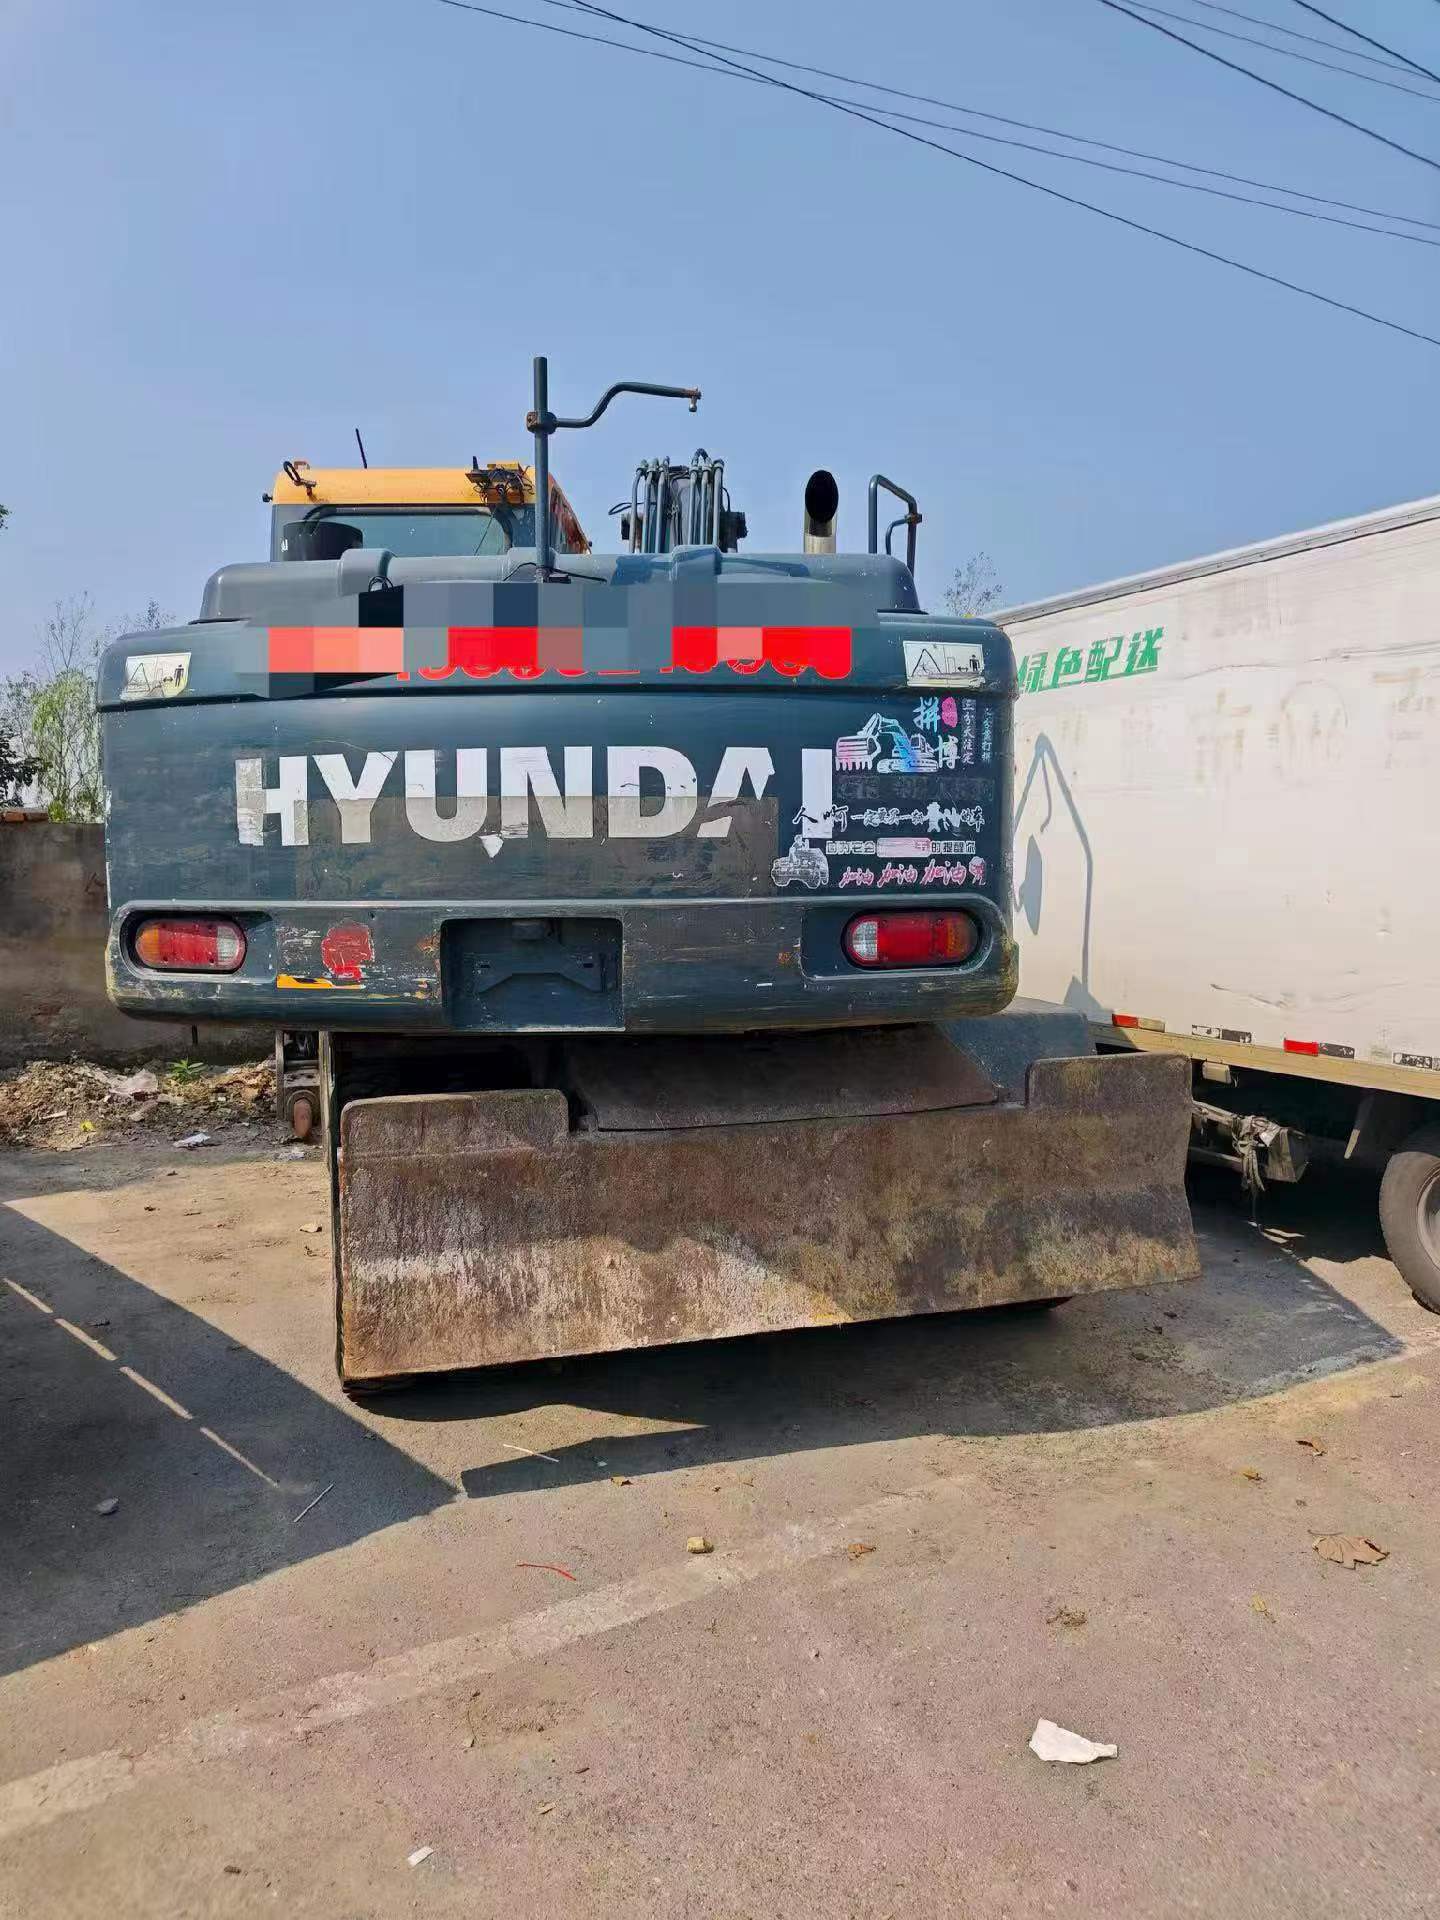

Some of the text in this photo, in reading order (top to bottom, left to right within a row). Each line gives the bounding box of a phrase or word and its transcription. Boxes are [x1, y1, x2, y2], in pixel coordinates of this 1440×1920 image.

[1018, 627, 1164, 693] 绿色配送
[839, 859, 967, 888] 加油 加油 加油
